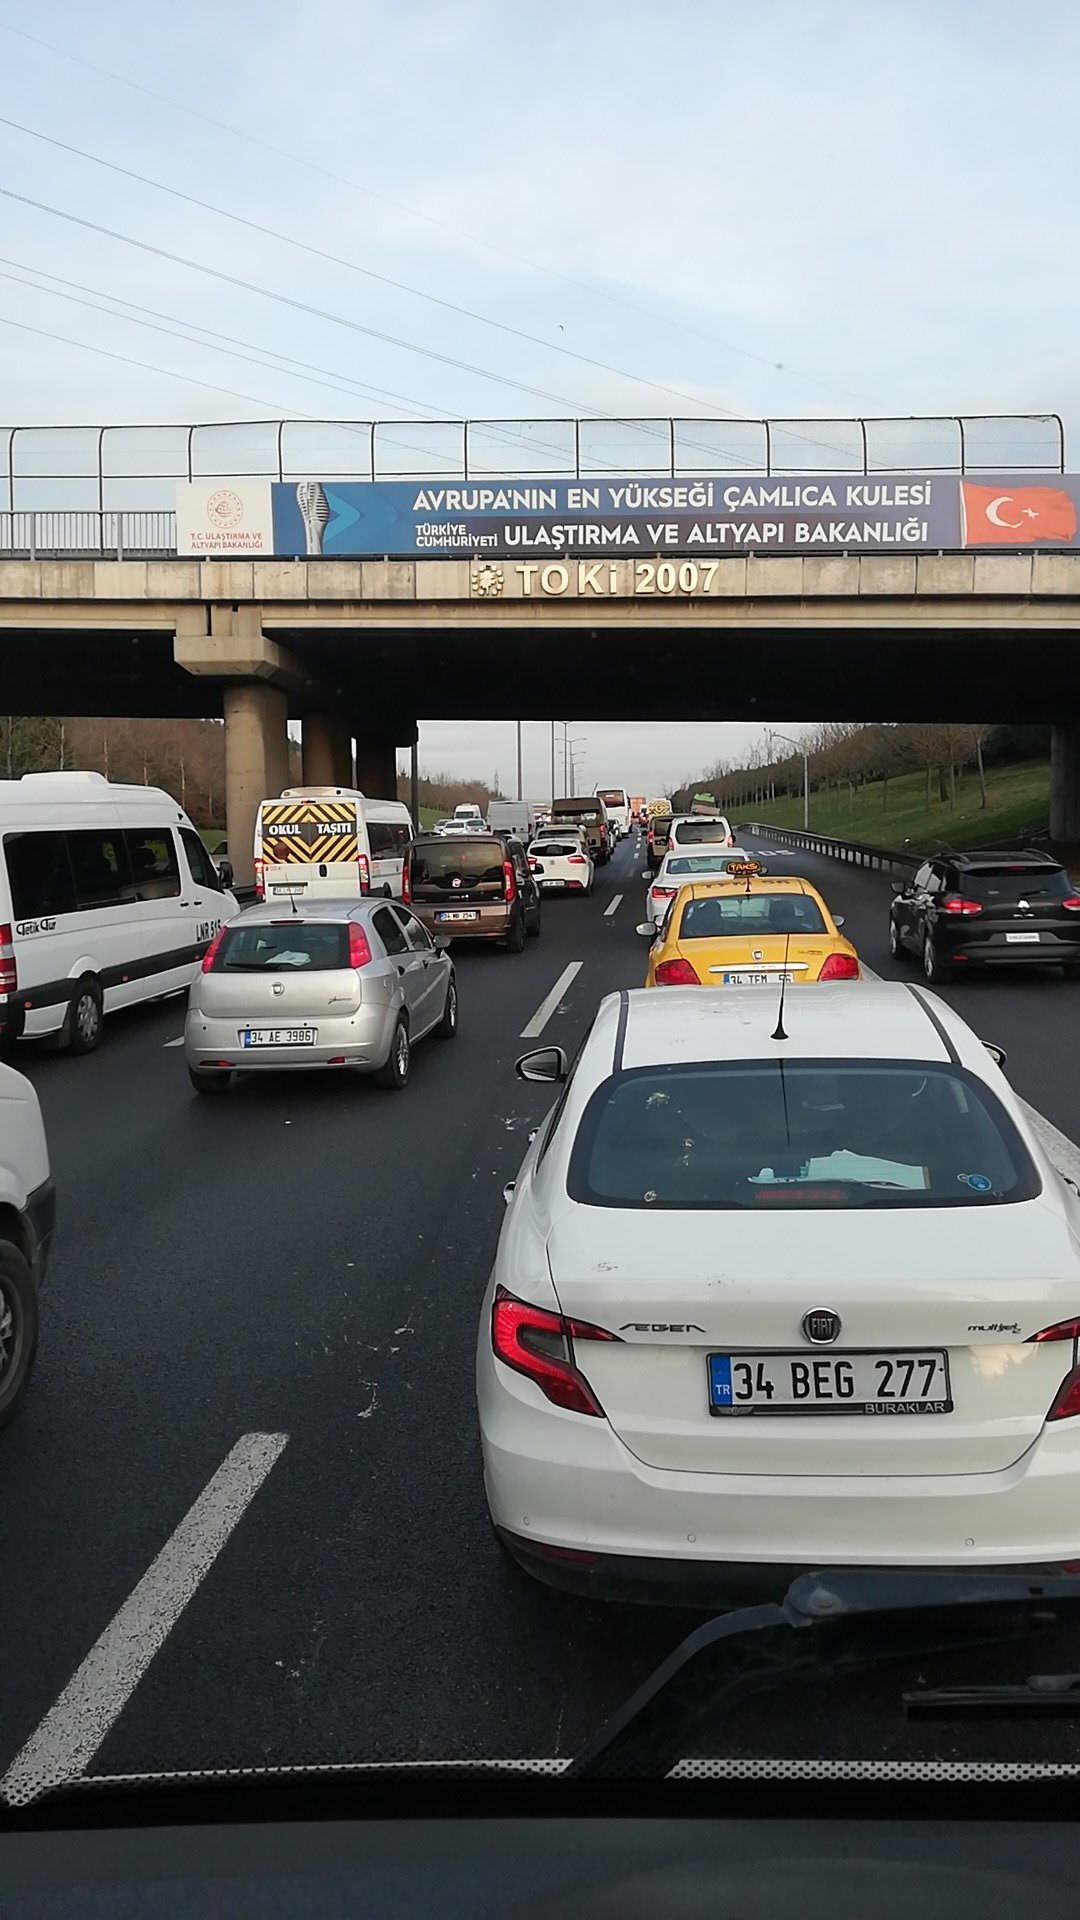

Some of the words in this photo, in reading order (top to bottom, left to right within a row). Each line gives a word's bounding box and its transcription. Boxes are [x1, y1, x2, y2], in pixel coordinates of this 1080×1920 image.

[412, 489, 557, 511] AVRUPA'NIN
[567, 488, 600, 509] EN
[608, 482, 714, 509] YÜKSEĞİ
[723, 486, 838, 512] ÇAMLICA
[846, 480, 932, 507] KULESİ
[415, 522, 467, 536] TÜRKİYE
[504, 524, 641, 551] ULAŞTIRMA
[646, 523, 679, 545] VE
[686, 522, 785, 544] ALTYAPI
[794, 517, 929, 543] BAKANLIĞI
[191, 541, 221, 549] ALTYAPI
[222, 540, 263, 549] BAKANLIĞI
[415, 533, 498, 548] CUMHURİYETİ
[635, 560, 720, 594] 2007
[268, 824, 302, 835] OKUL
[316, 823, 352, 836] TAŞITI
[251, 1031, 264, 1043] 34
[268, 1031, 282, 1043] AE
[285, 1030, 312, 1042] 3986
[810, 1317, 834, 1338] FIAT
[733, 1362, 775, 1400] 34
[790, 1360, 855, 1399] BEG
[874, 1358, 937, 1398] 277
[715, 1383, 731, 1396] TR
[864, 1401, 946, 1414] BURAKLAR
